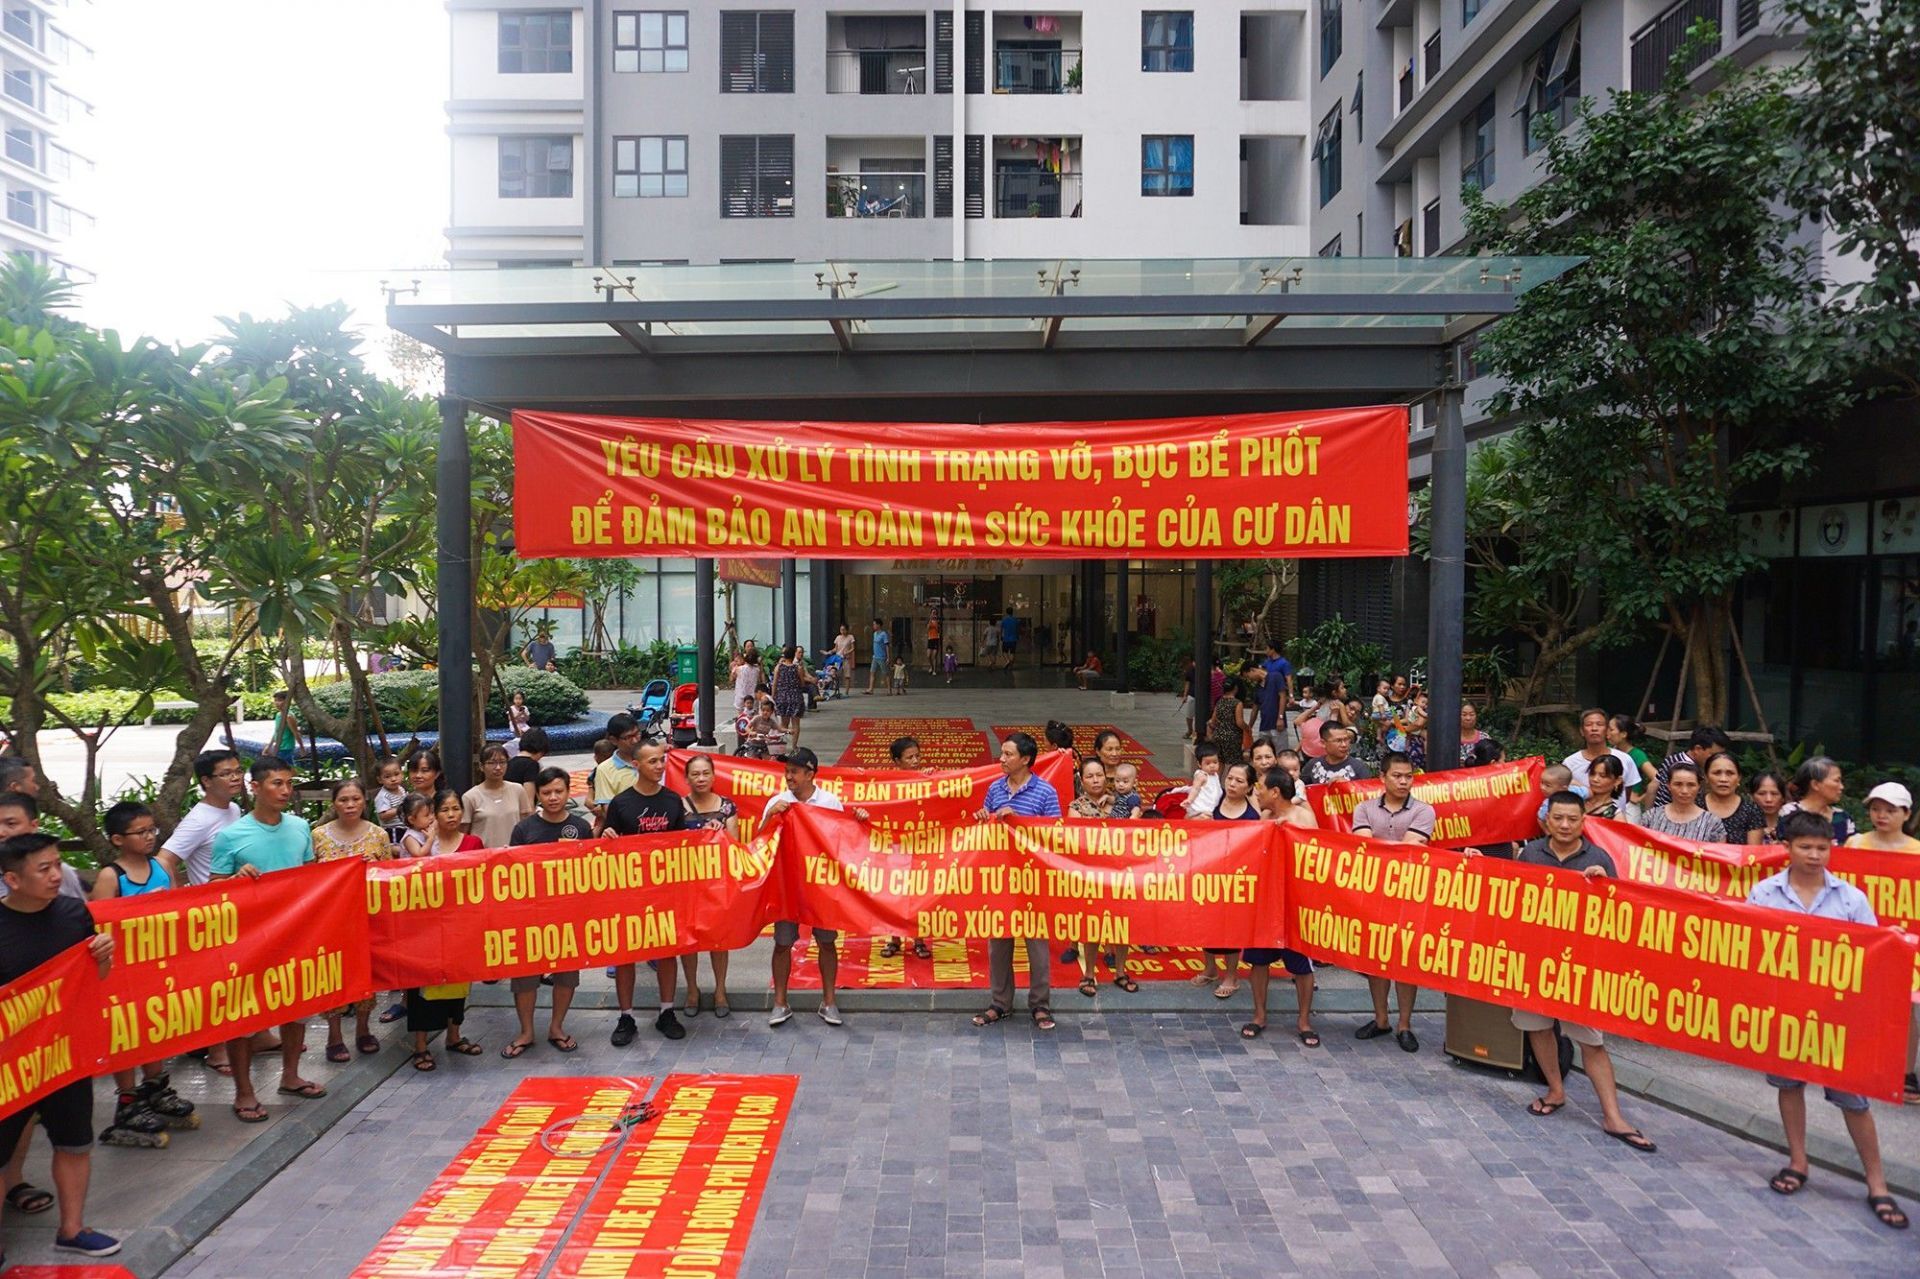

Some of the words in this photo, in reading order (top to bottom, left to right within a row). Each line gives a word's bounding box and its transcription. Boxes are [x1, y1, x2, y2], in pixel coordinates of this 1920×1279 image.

[600, 435, 661, 478] YÊU
[670, 433, 736, 480] CẦU
[746, 436, 794, 482] XỬ
[799, 442, 837, 483] LÝ
[845, 441, 920, 483] TÌNH
[930, 448, 1040, 491] TRẠNG
[1051, 440, 1102, 485] VỠ,
[1112, 442, 1178, 488] BỤC
[1188, 429, 1230, 478] BỂ
[1240, 424, 1322, 478] PHỐT
[571, 490, 615, 545] ĐỂ
[622, 494, 697, 545] ĐẢM
[707, 494, 771, 546] BẢO
[782, 508, 827, 546] AN
[836, 502, 922, 547] TOÀN
[931, 502, 975, 547] VÀ
[985, 501, 1050, 547] SỨC
[1061, 496, 1146, 547] KHỎE
[1158, 493, 1222, 548] CỦA
[1232, 501, 1278, 545] CƯ
[1285, 496, 1351, 545] DÂN
[731, 768, 776, 797] TREO
[854, 777, 891, 801] BÁN
[895, 781, 933, 806] THỊT
[937, 774, 973, 799] CHÓ
[1411, 780, 1449, 805] HƯỜNG
[1453, 776, 1489, 801] CHÍNH
[900, 827, 946, 859] NGHỊ
[951, 819, 1009, 854] CHÍNH
[1015, 816, 1078, 856] QUYỀN
[1084, 820, 1124, 857] VÀO
[1132, 824, 1188, 863] CUỘC
[1445, 812, 1472, 840] DÂN
[389, 861, 444, 913] ĐẦU
[450, 862, 487, 906] TƯ
[492, 859, 536, 901] COI
[542, 845, 642, 896] THƯỜNG
[649, 838, 722, 885] CHÍNH
[805, 853, 840, 886] YÊU
[845, 856, 884, 894] CẦU
[889, 861, 928, 897] CHỦ
[934, 858, 973, 896] ĐẦU
[979, 864, 1007, 896] TƯ
[1008, 856, 1040, 897] ĐỐI
[1046, 867, 1104, 905] THOẠI
[1111, 862, 1137, 901] VÀ
[1143, 862, 1186, 902] GIẢI
[1192, 863, 1257, 904] QUYẾT
[1628, 841, 1670, 886] YÊU
[1674, 847, 1720, 894] CẦU
[121, 910, 180, 969] THỊT
[187, 892, 239, 951] CHÓ
[484, 928, 517, 967] ĐE
[526, 921, 579, 969] DỌA
[585, 913, 621, 956] CƯ
[627, 905, 678, 951] DÂN
[918, 904, 960, 938] BỨC
[965, 905, 1005, 939] XÚC
[1010, 899, 1050, 940] CỦA
[1054, 908, 1085, 942] CƯ
[1087, 909, 1130, 945] DÂN
[1293, 838, 1333, 884] YÊU
[1334, 842, 1381, 894] CẦU
[1383, 852, 1432, 903] CHỦ
[1433, 858, 1483, 913] ĐẦU
[1488, 874, 1522, 919] TƯ
[1521, 872, 1580, 932] ĐẢM
[1583, 885, 1633, 944] BẢO
[1637, 906, 1677, 954] AN
[1682, 915, 1752, 971] SINH
[1757, 924, 1800, 982] XÃ
[1808, 933, 1865, 1000] HỘI
[102, 994, 139, 1055] ÀI
[146, 976, 202, 1044] SẢN
[210, 961, 260, 1026] CỦA
[262, 957, 297, 1010] CƯ
[301, 945, 344, 1000] DÂN
[1298, 904, 1363, 956] KHÔNG
[1368, 921, 1399, 971] TỰ
[1401, 921, 1416, 968] Ý
[1418, 921, 1465, 979] CẮT
[1468, 940, 1531, 998] ĐIỆN,
[1538, 945, 1587, 1006] CẮT
[1589, 968, 1660, 1026] NƯỚC
[1666, 977, 1722, 1044] CỦA
[1730, 1002, 1776, 1054] CƯ
[1778, 1009, 1847, 1071] DÂN
[17, 1045, 42, 1094] CƯ
[503, 1105, 557, 1125] DÂN
[664, 1086, 717, 1111] ĐÍCH
[734, 1095, 780, 1116] CAO
[653, 1111, 710, 1137] MỤC
[727, 1117, 780, 1132] VỤ
[714, 1134, 770, 1162] DỊCH
[539, 1159, 593, 1175] THI
[702, 1163, 755, 1187] PHÍ
[519, 1176, 580, 1198] KẾT
[615, 1178, 678, 1207] DỌA
[504, 1200, 566, 1227] CAM
[602, 1209, 657, 1229] ĐE
[681, 1189, 746, 1229] ĐÓNG
[475, 1227, 547, 1265] ĐÚNG
[591, 1232, 646, 1247] VI
[665, 1232, 731, 1266] DÂN
